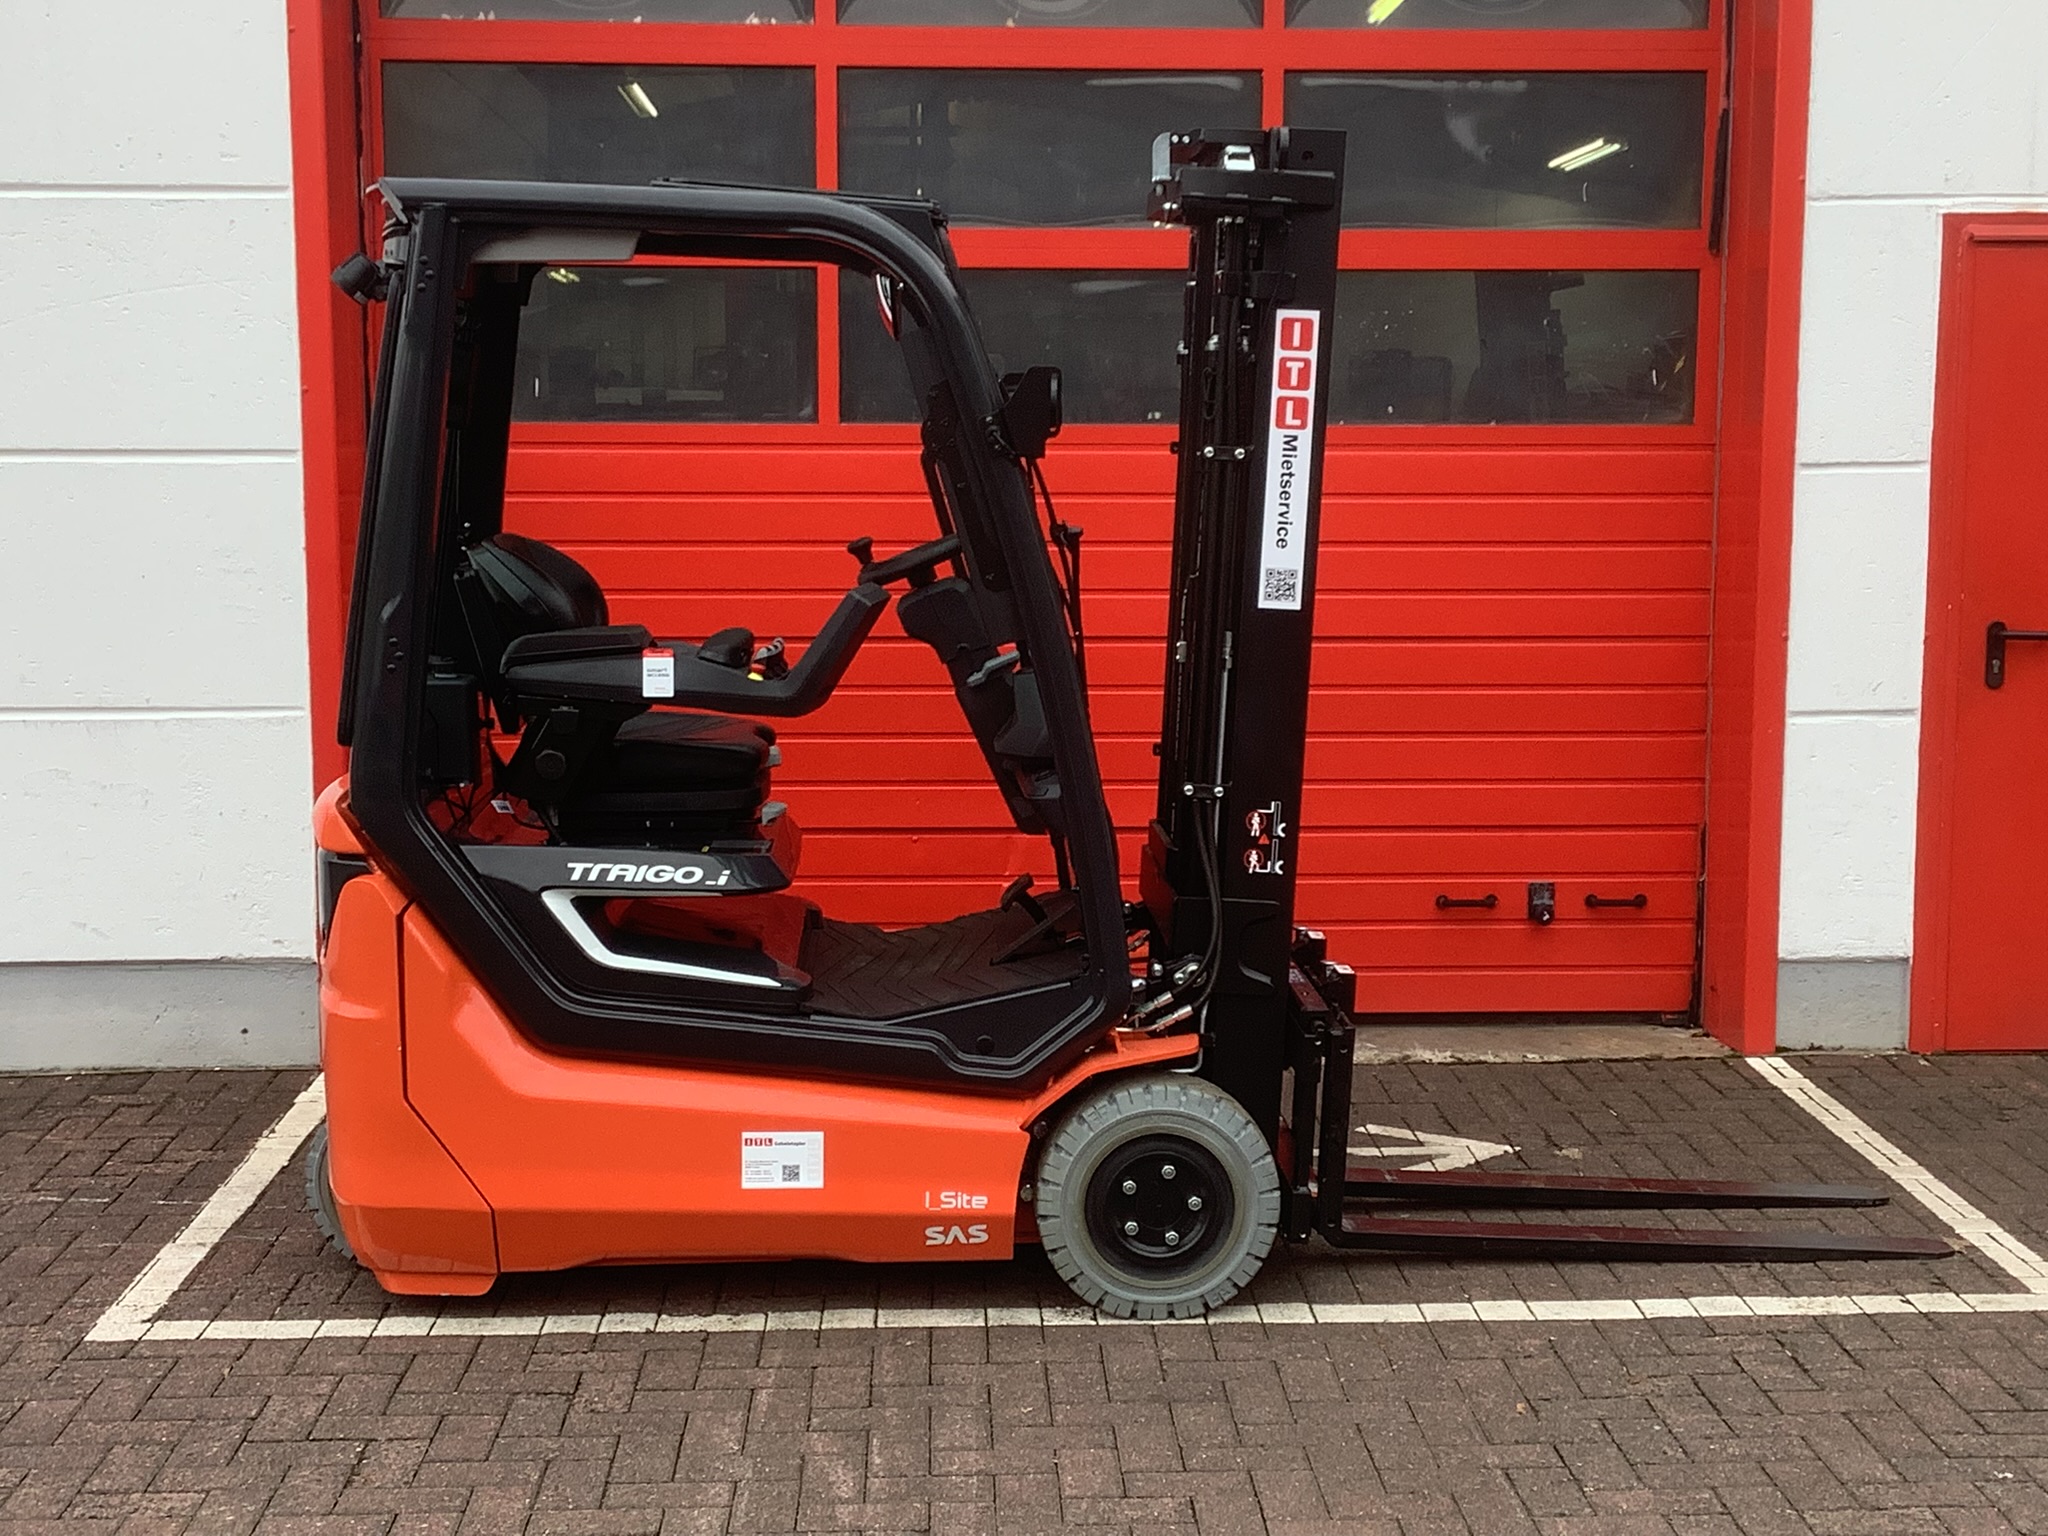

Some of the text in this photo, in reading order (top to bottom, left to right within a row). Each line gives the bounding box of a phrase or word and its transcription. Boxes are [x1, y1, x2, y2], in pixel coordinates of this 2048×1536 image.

[1275, 318, 1309, 550] ITL Mietservice
[744, 1138, 773, 1147] ITL
[925, 1224, 989, 1246] SAS
